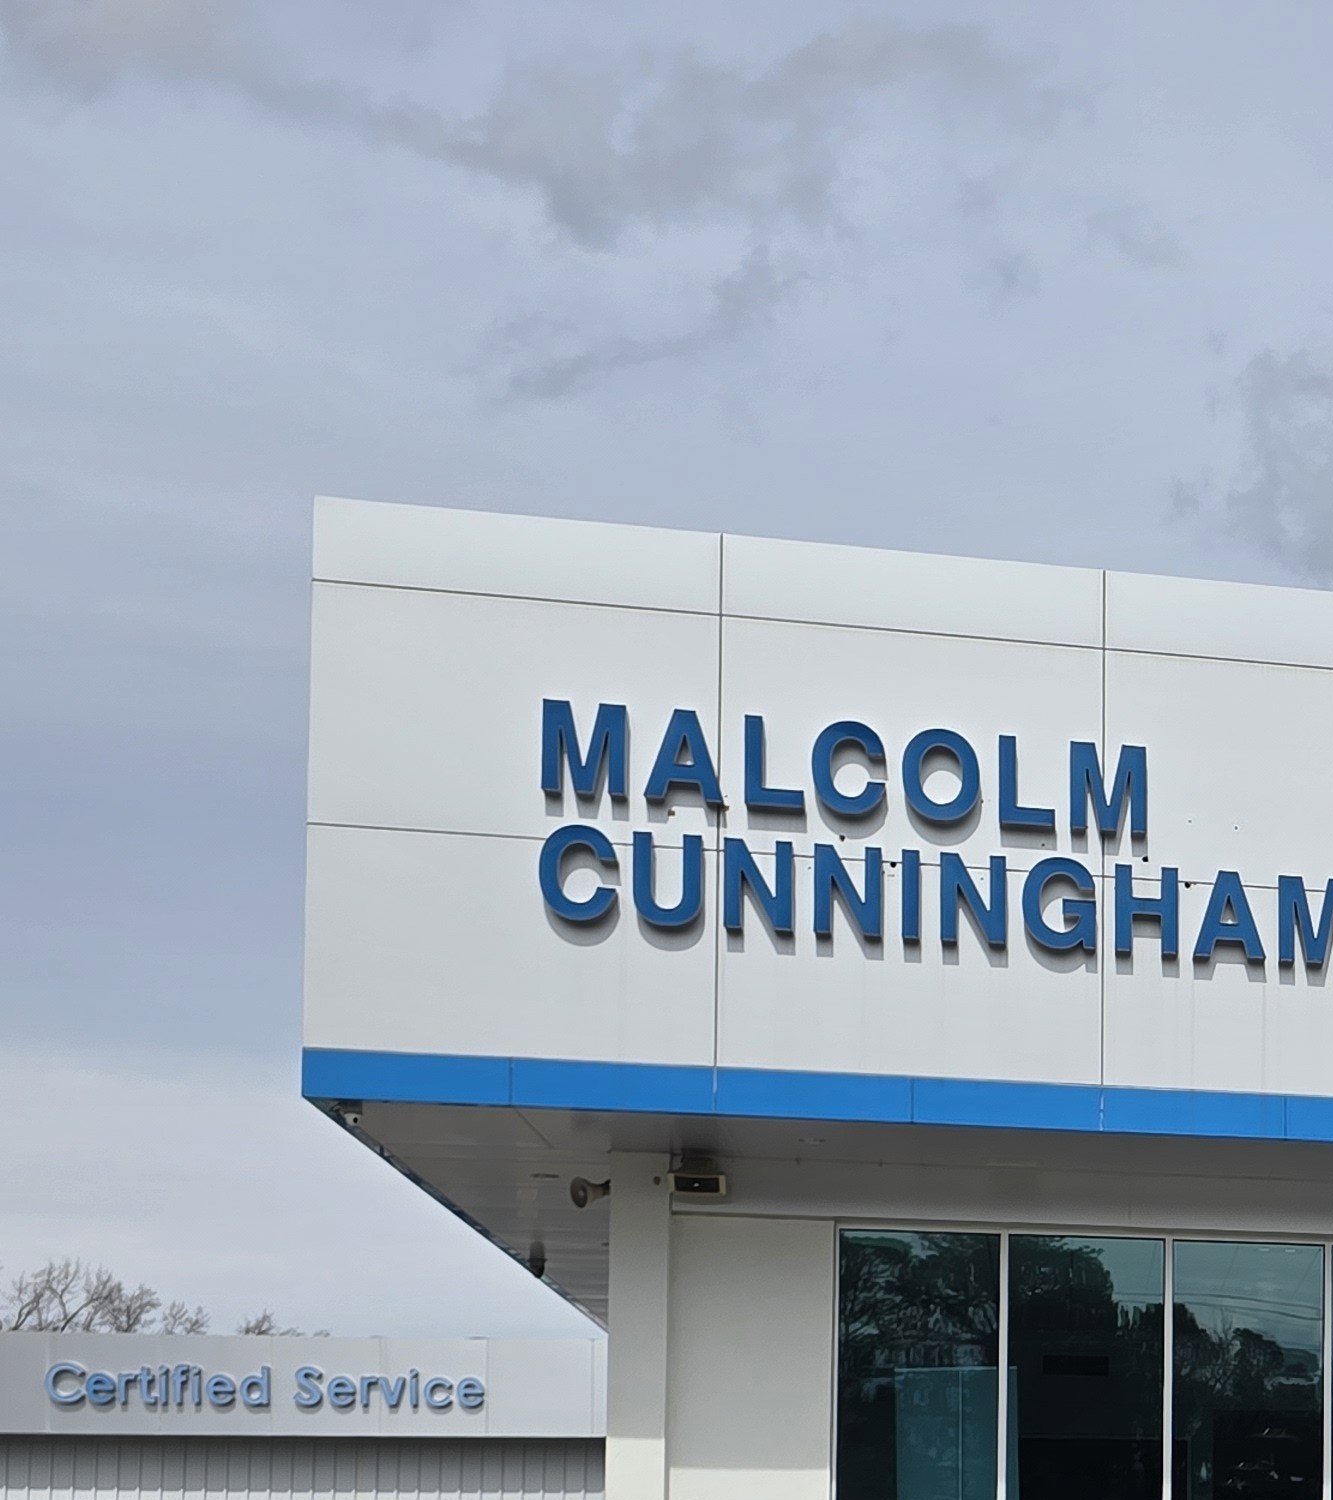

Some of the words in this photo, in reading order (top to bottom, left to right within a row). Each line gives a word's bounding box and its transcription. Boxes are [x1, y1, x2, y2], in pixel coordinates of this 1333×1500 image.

[541, 697, 1148, 839] MALCOLM
[44, 1361, 272, 1409] Certified
[293, 1366, 486, 1410] Service
